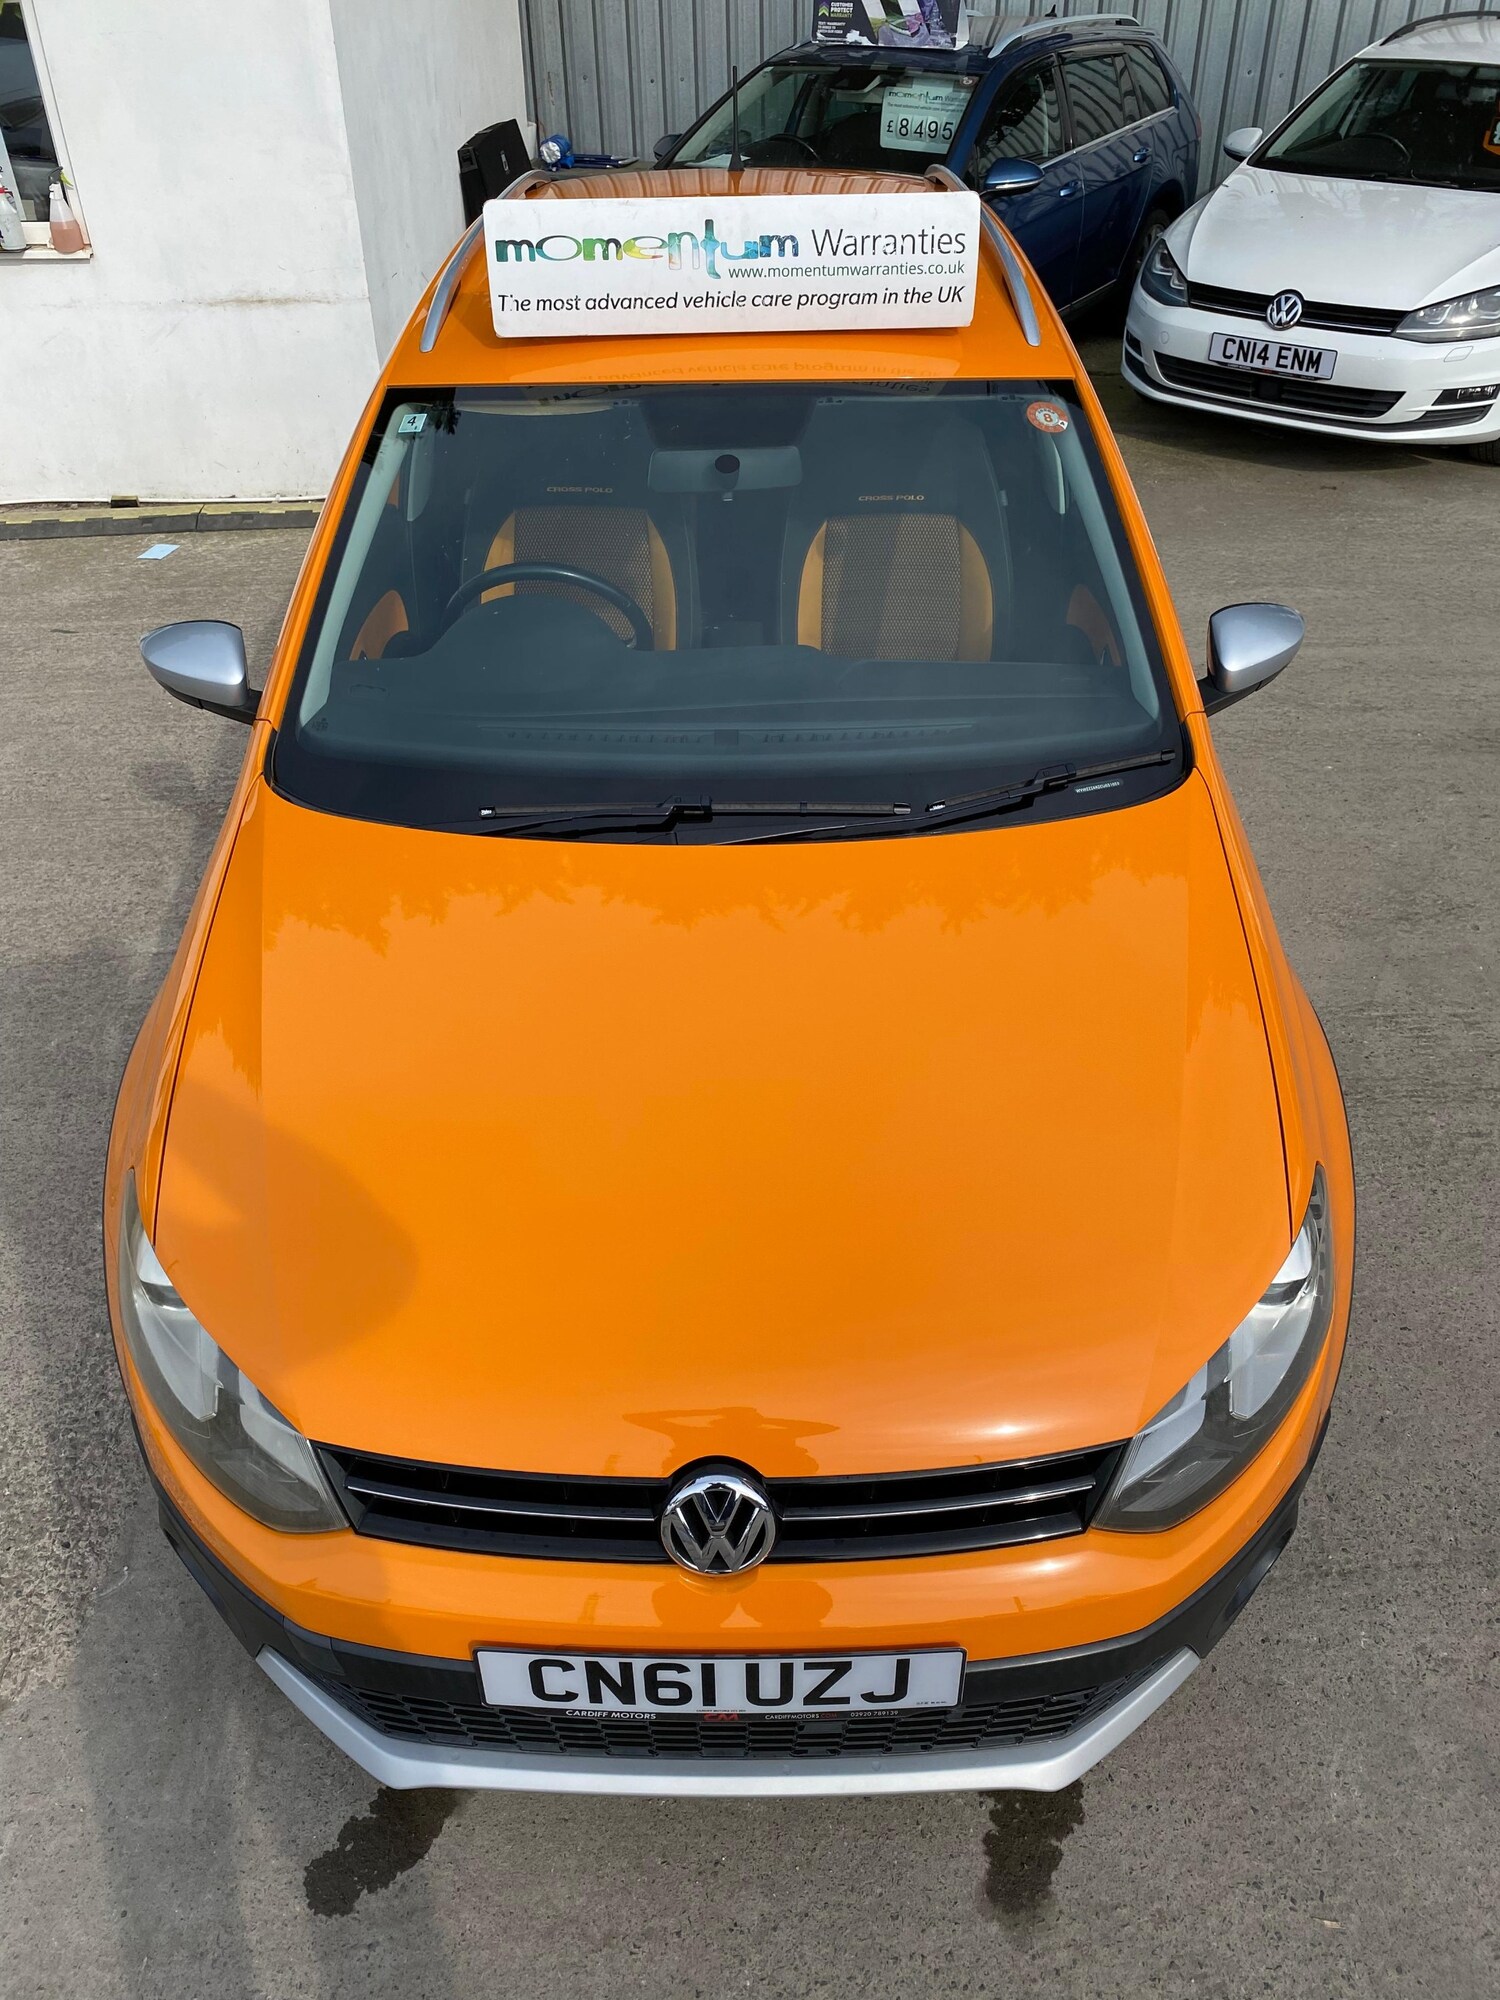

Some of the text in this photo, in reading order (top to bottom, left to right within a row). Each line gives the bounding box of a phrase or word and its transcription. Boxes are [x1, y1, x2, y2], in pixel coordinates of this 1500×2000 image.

[495, 219, 966, 279] momentum Warranties
[728, 260, 965, 279] www.momentumwarranties.co.uk
[536, 295, 581, 311] most
[585, 291, 678, 311] advanced
[682, 290, 747, 308] vehicle
[751, 293, 793, 307] care
[797, 293, 878, 310] program
[882, 287, 899, 304] in
[903, 287, 933, 303] the
[938, 285, 966, 302] UK
[1222, 337, 1323, 374] CN14 ENM
[407, 416, 417, 426] 4
[584, 486, 614, 494] POLO
[565, 1709, 657, 1720] CARDIFF MOTORS
